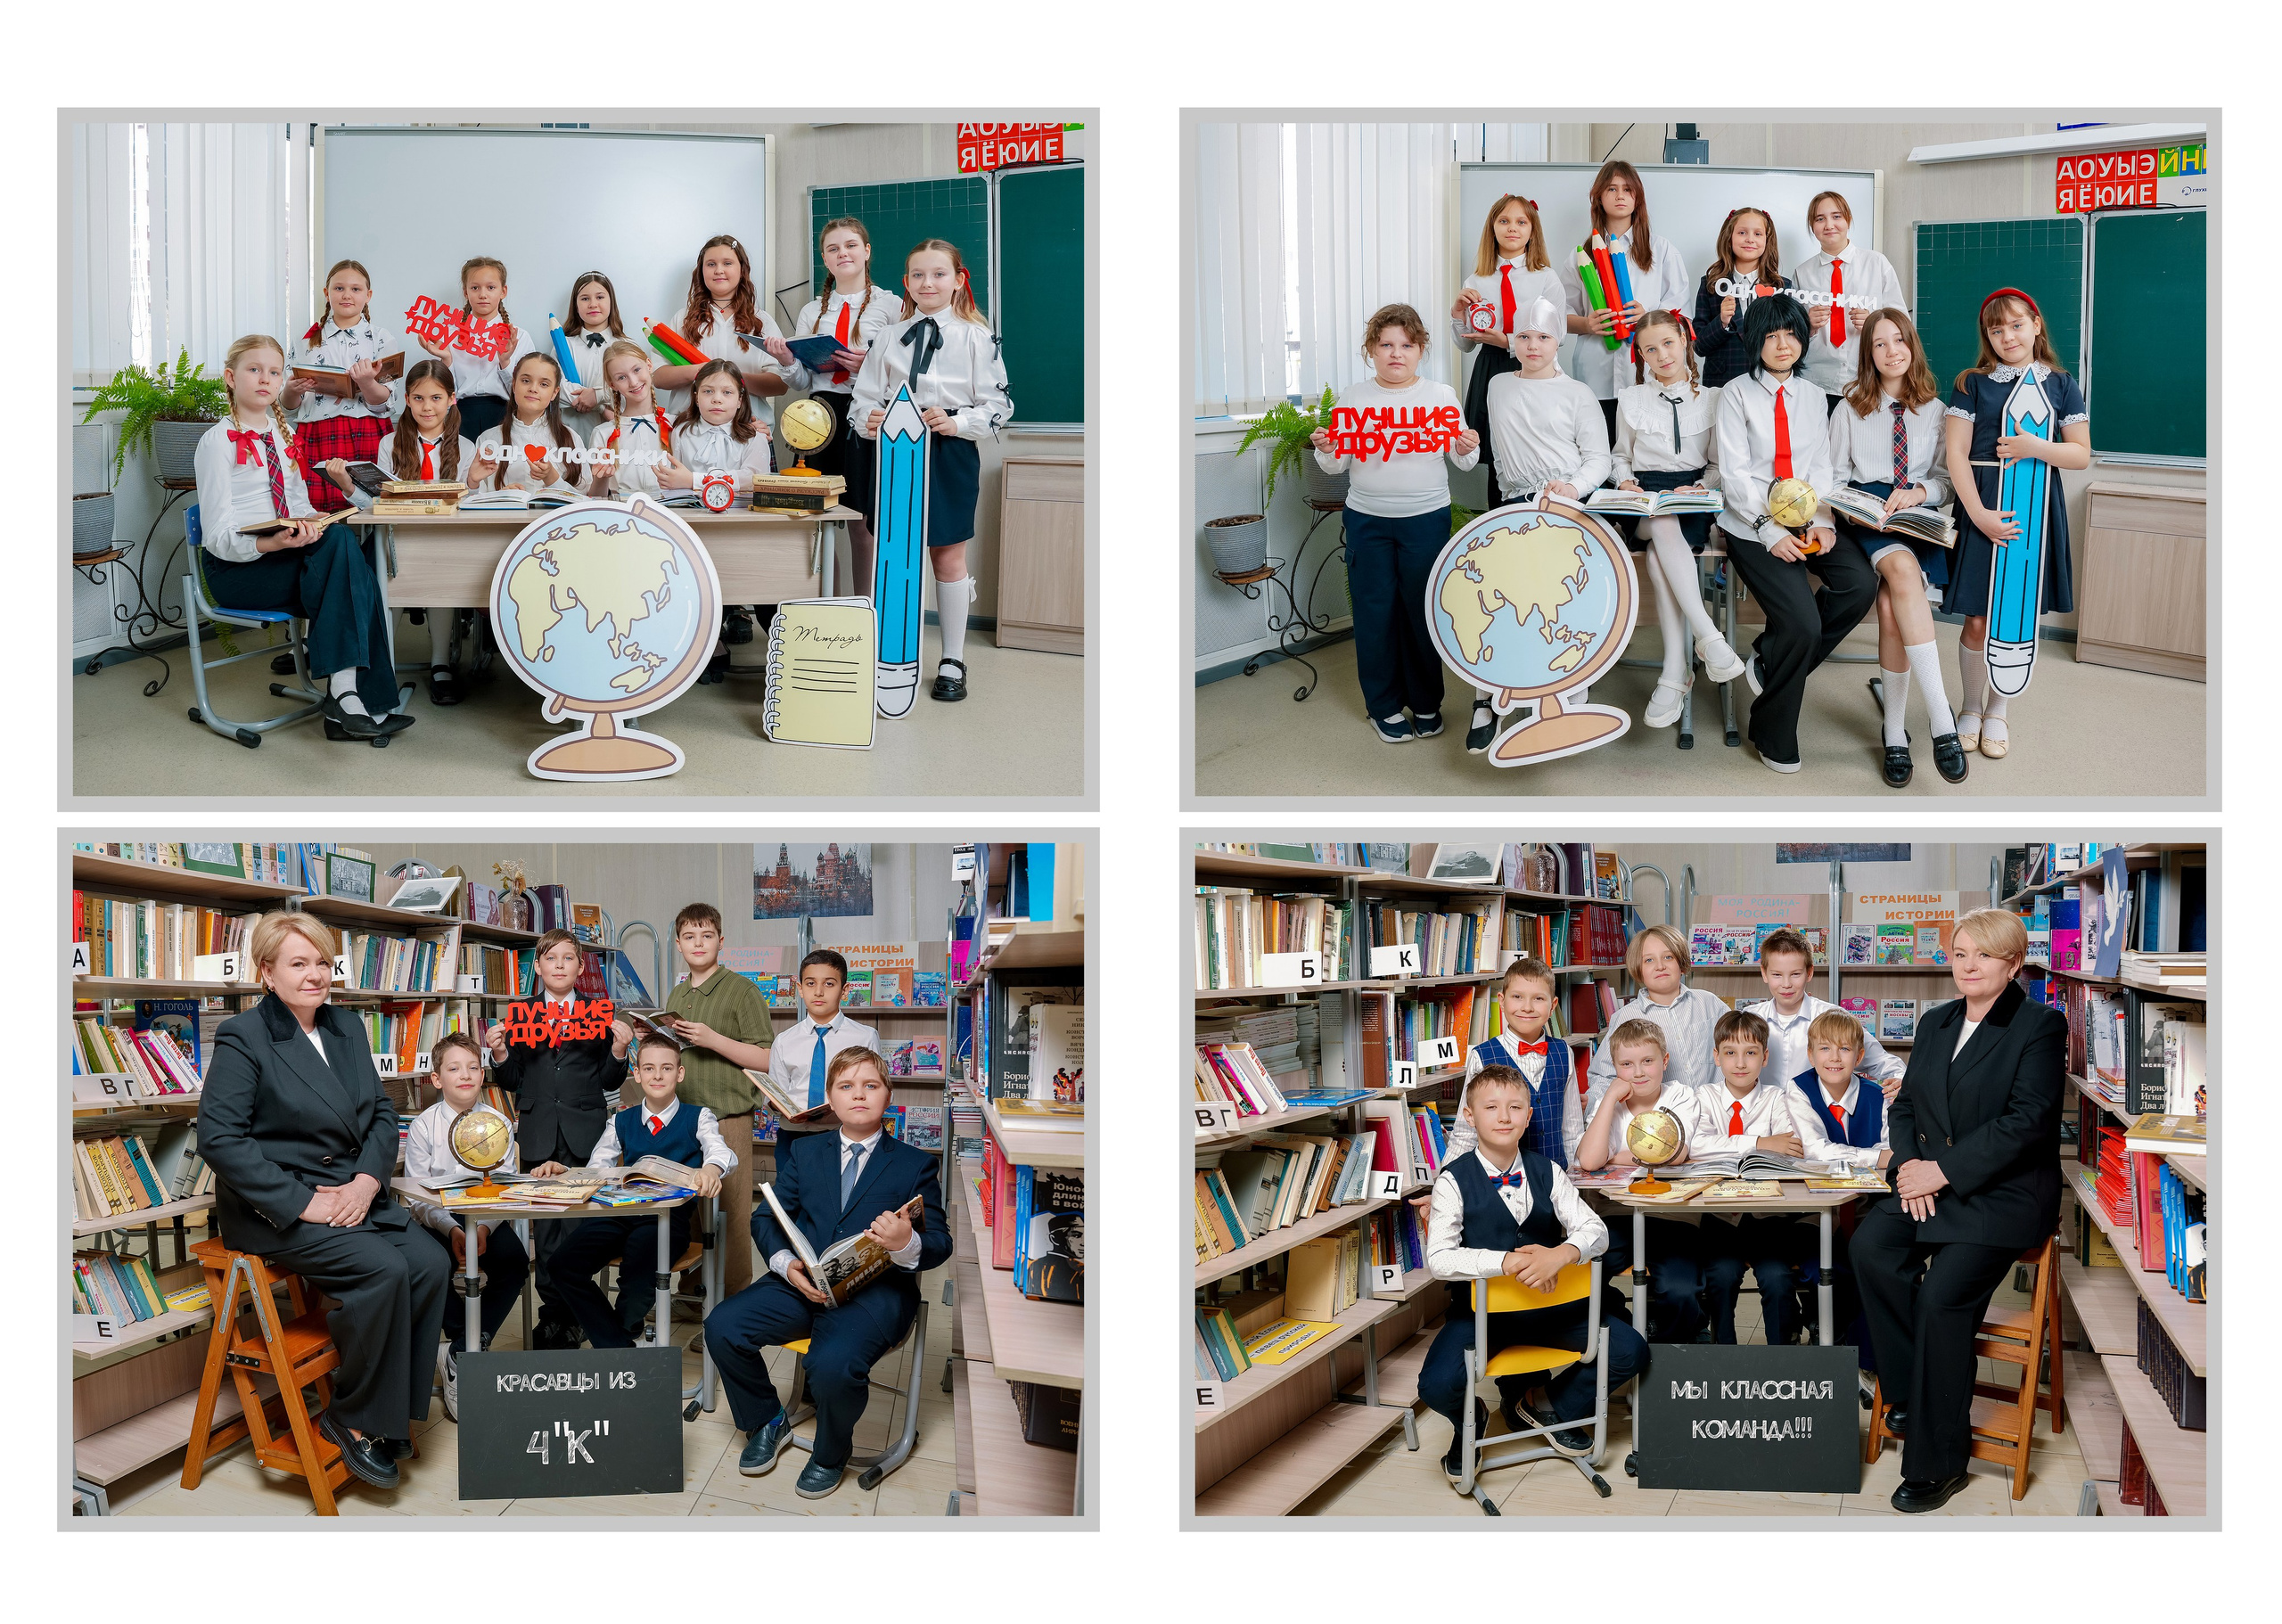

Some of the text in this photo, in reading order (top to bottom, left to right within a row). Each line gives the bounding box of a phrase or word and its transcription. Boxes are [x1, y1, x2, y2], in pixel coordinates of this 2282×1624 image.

[1332, 406, 1460, 432] лучшие
[1335, 431, 1450, 463] друзья
[1718, 898, 1744, 906] МОЯ
[1859, 895, 1941, 904] СТРАНИЦЫ
[1736, 909, 1790, 918] РОССИЯ!
[1885, 910, 1954, 920] ИСТОРИИ
[73, 948, 86, 968] А
[850, 958, 915, 968] ИСТОРИИ
[1400, 950, 1412, 967] К
[224, 959, 234, 975] Б
[334, 961, 344, 975] К
[1301, 959, 1314, 978] Б
[471, 978, 480, 988] Т
[164, 1003, 193, 1011] ГОГОЛЬ
[507, 999, 614, 1023] лучшие
[510, 1021, 605, 1048] друзья
[1438, 1042, 1453, 1058] М
[381, 1059, 392, 1071] М
[419, 1056, 428, 1068] Н
[1400, 1068, 1412, 1084] Л
[100, 1079, 134, 1096] В Г
[1195, 1109, 1232, 1127] В Г
[1416, 1168, 1428, 1180] П
[1383, 1176, 1399, 1193] Д
[1383, 1269, 1394, 1284] Р
[96, 1321, 113, 1337] Е
[497, 1371, 637, 1392] КРАСАВЦЫ ИЗ
[1196, 1388, 1214, 1405] Е
[1721, 1381, 1834, 1399] КЛАССНАЯ
[1692, 1417, 1813, 1441] КОМАНДА!!!
